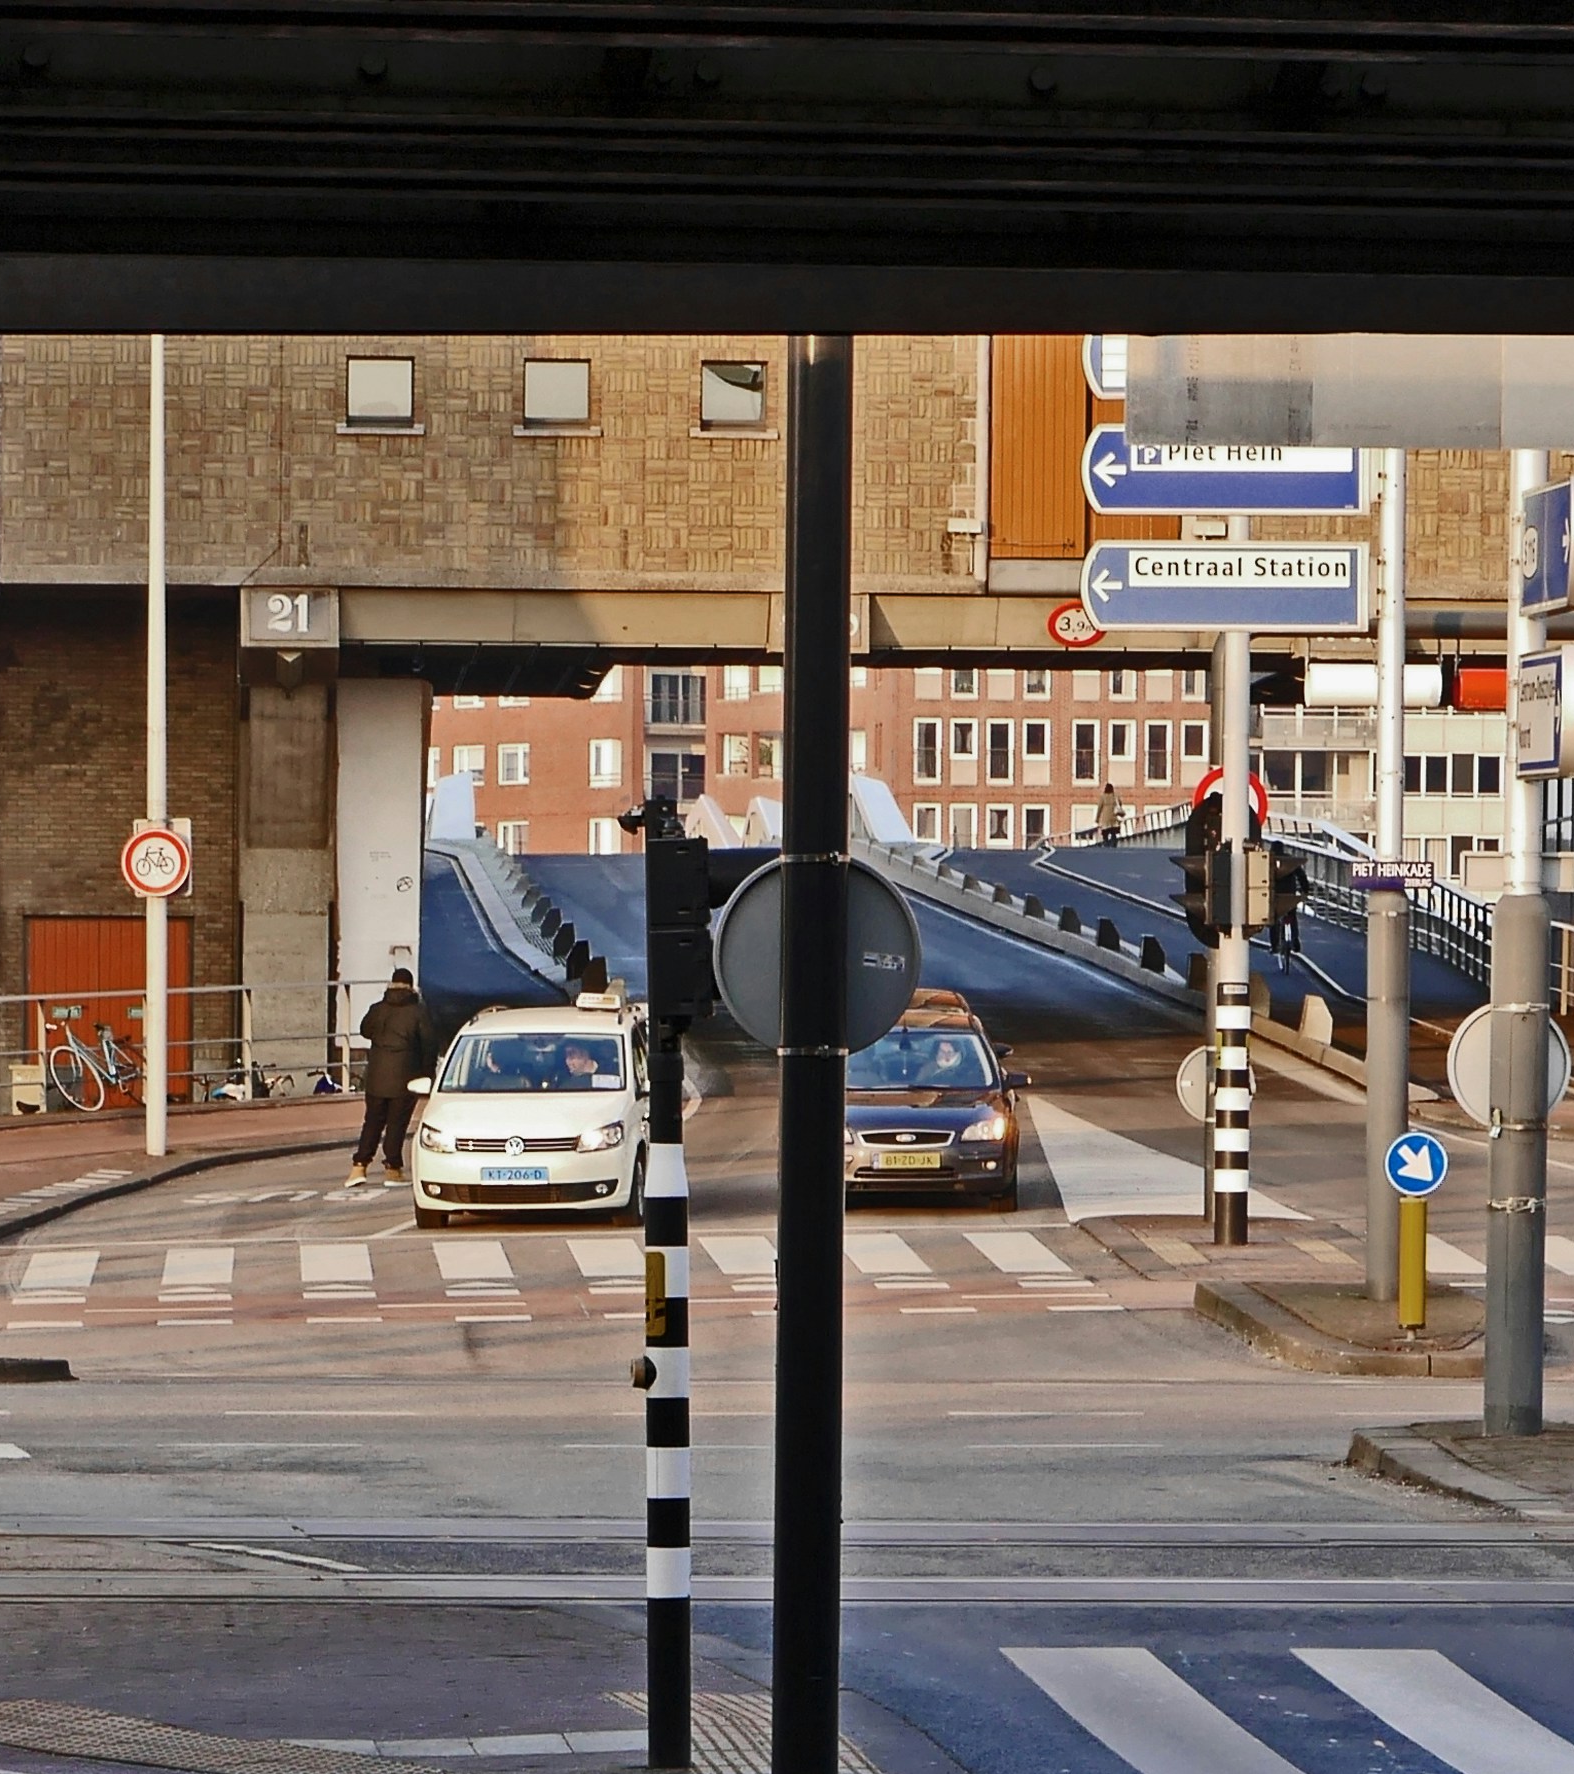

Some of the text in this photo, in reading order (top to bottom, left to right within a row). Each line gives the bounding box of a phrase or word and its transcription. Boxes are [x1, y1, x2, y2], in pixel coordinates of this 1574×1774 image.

[1168, 445, 1216, 461] Piet
[1227, 445, 1282, 461] Hein
[1135, 556, 1347, 577] Centraal Station
[267, 594, 309, 633] 21
[1352, 863, 1432, 877] PIET HEINKADE
